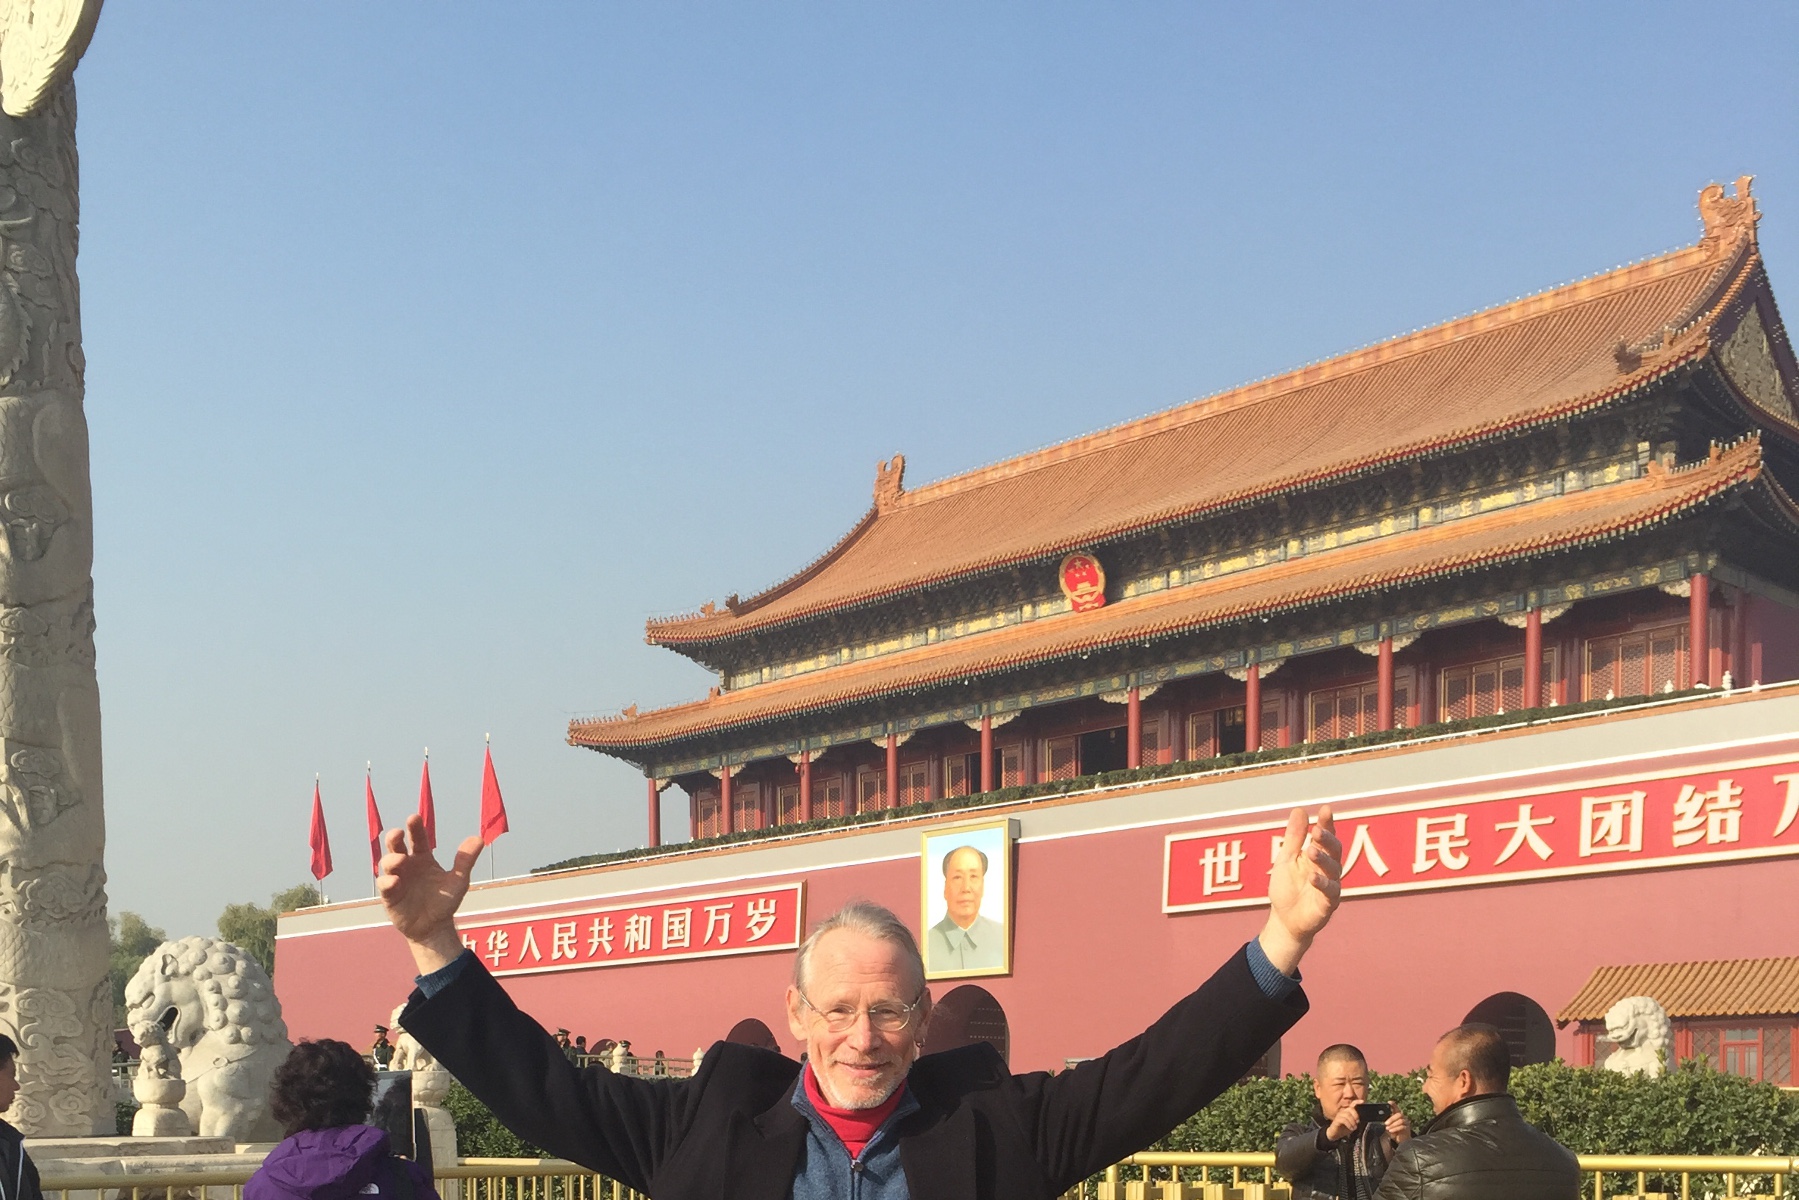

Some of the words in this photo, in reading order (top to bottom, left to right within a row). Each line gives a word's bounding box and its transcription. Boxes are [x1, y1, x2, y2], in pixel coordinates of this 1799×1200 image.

[1199, 773, 1799, 896] 世人民大团结
